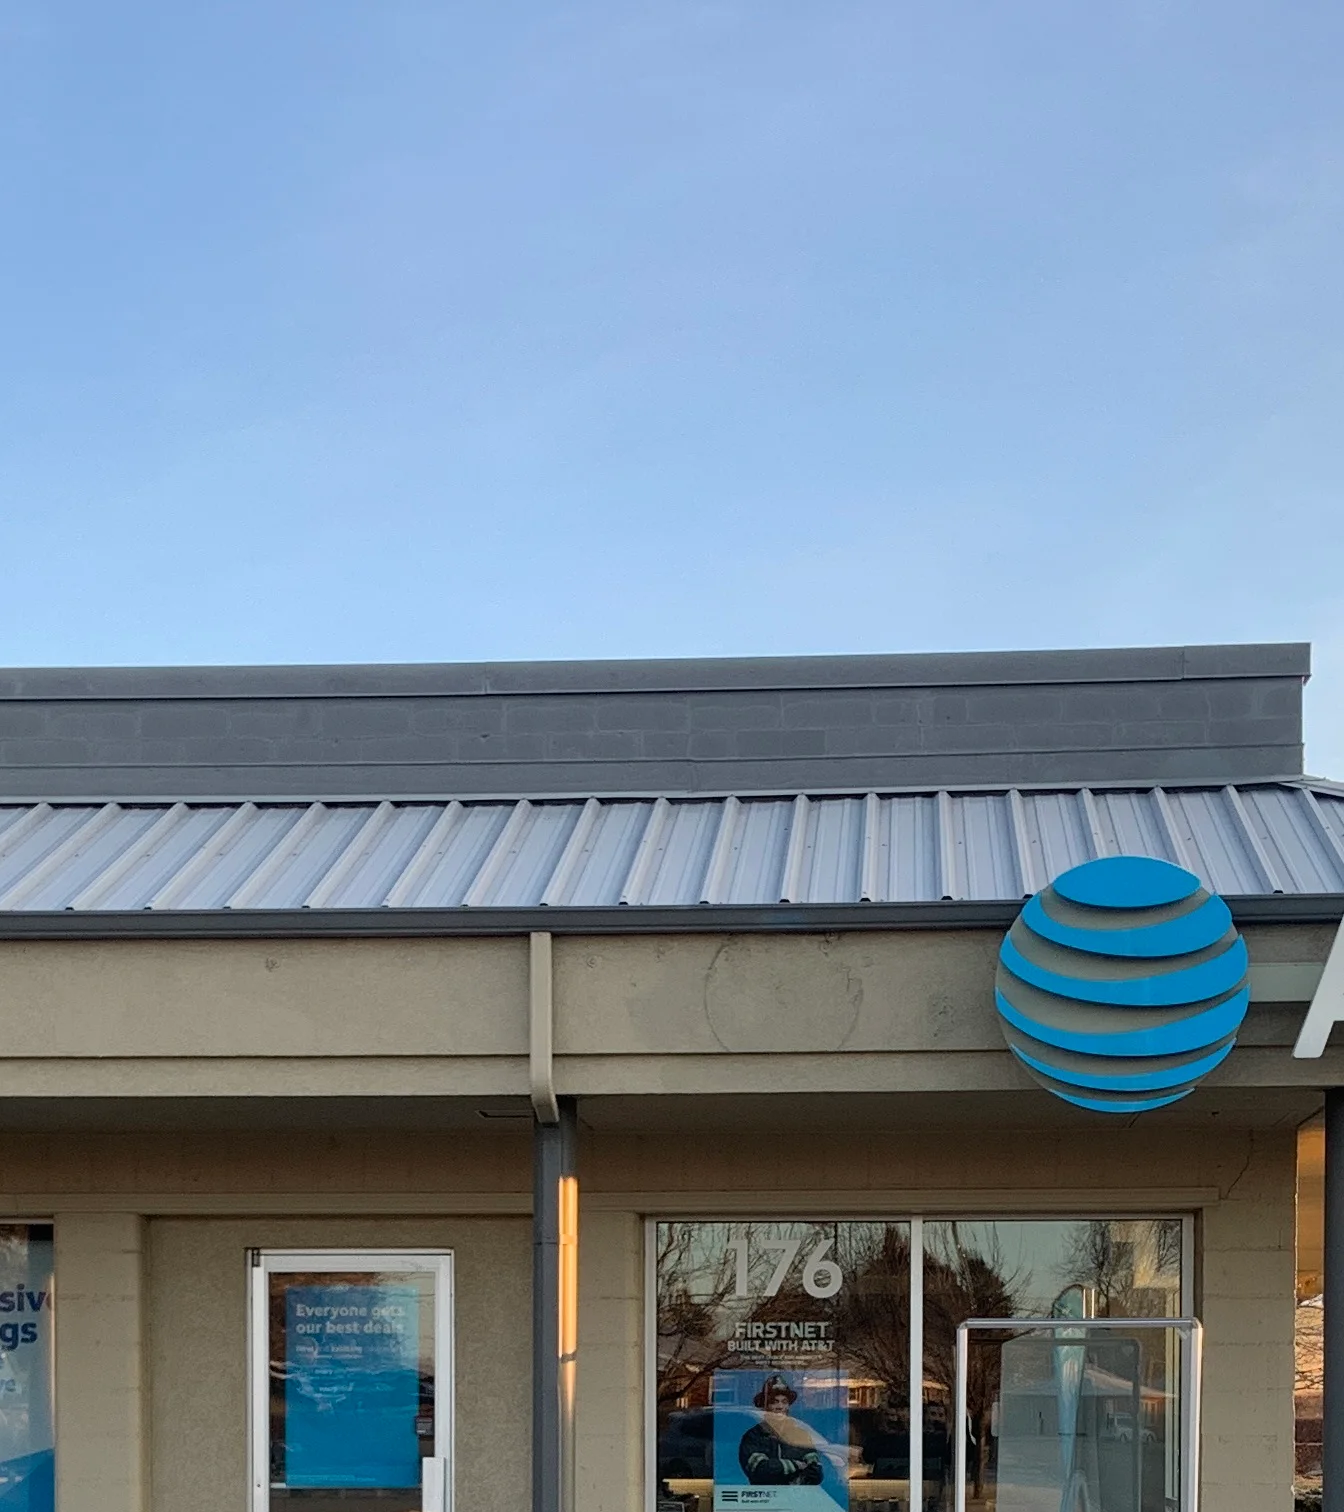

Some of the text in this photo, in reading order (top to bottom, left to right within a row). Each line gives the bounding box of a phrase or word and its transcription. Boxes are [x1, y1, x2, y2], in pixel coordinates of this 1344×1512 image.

[725, 1239, 843, 1299] 176
[295, 1303, 367, 1320] Everyone
[296, 1321, 405, 1334] our best deals
[735, 1322, 830, 1338] FIRSTNET
[727, 1340, 835, 1352] BUILT WITH AT&T
[741, 1490, 777, 1498] FIRSTNET
